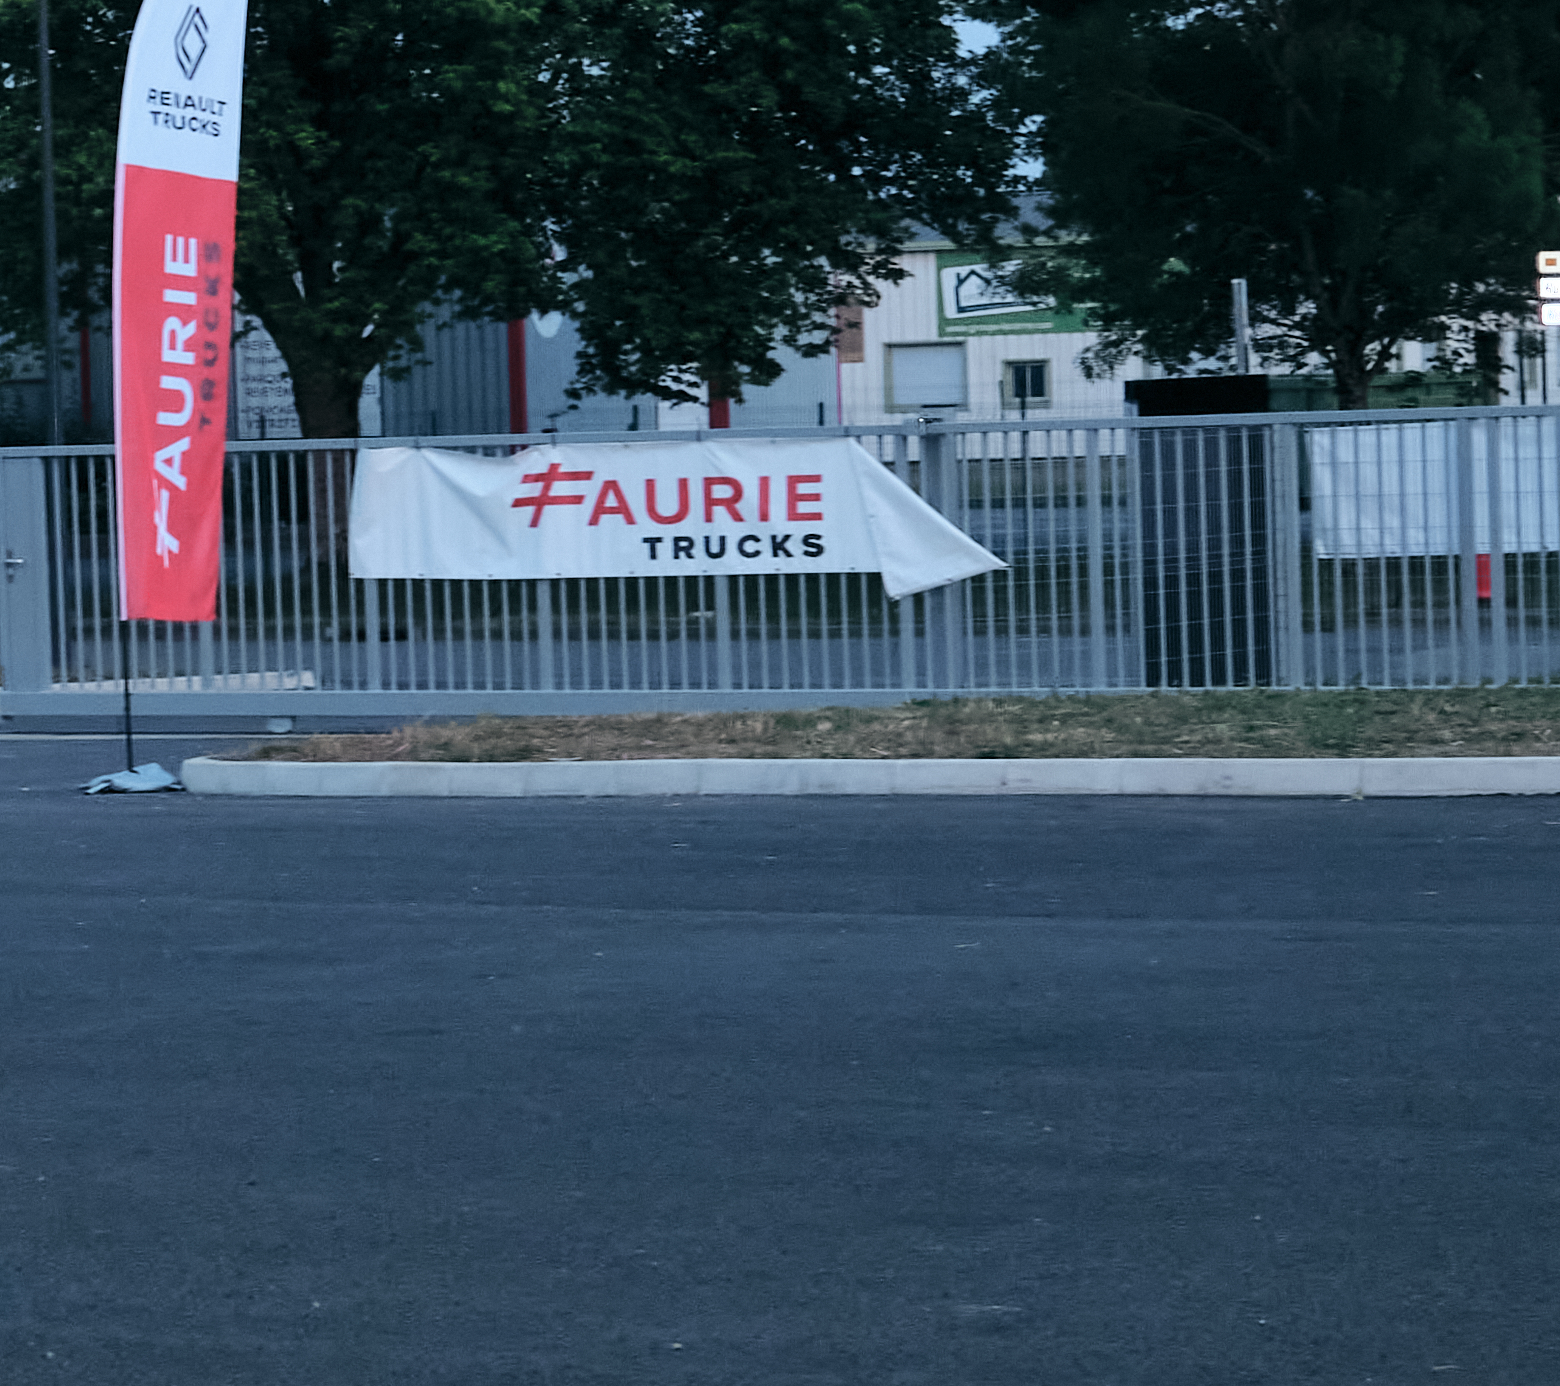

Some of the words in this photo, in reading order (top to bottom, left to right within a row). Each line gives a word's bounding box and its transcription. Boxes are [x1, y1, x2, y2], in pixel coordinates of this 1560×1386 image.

[146, 87, 228, 116] RENAULT
[149, 110, 221, 137] TRUCKS
[197, 240, 223, 431] TRUCKS
[152, 233, 199, 568] FAURIE
[511, 463, 824, 528] FAURIE
[643, 533, 825, 560] TRUCKS
